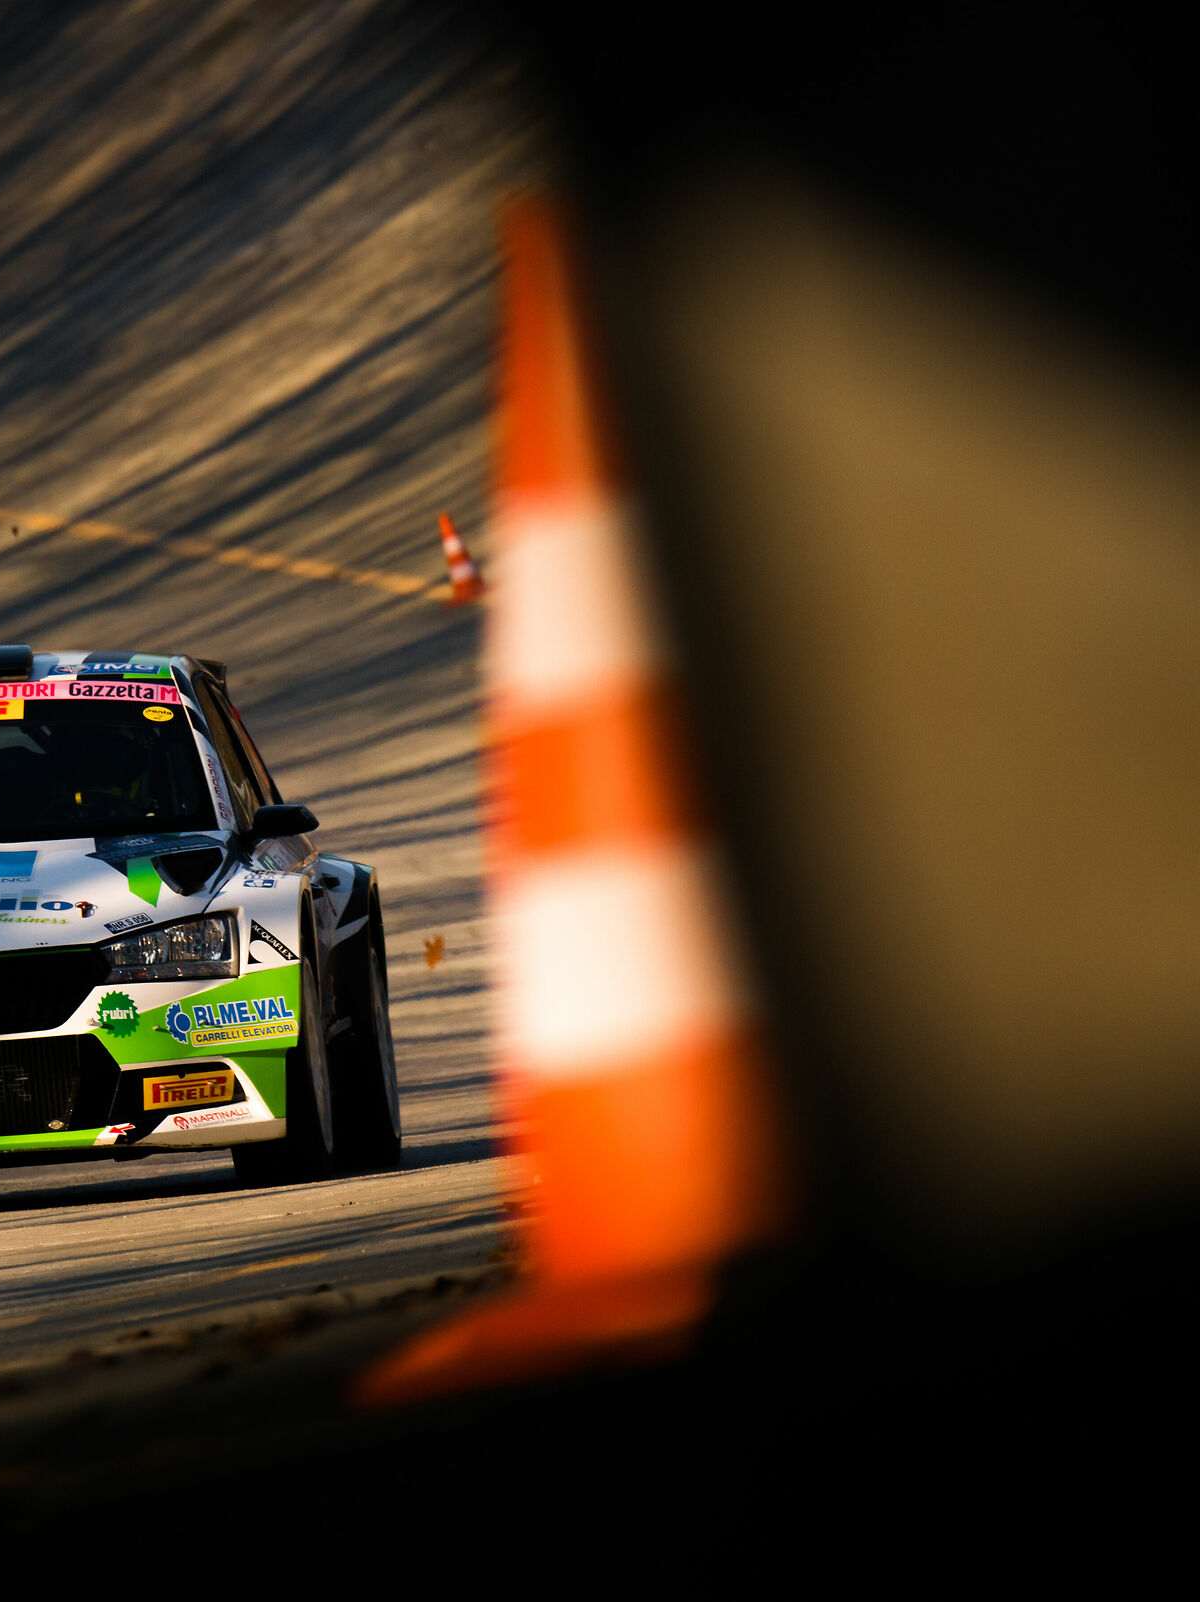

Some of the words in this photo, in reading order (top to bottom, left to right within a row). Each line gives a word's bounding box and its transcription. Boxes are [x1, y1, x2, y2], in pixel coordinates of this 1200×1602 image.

[69, 683, 154, 699] Gazzetta
[160, 687, 182, 701] M
[251, 924, 294, 960] ACQUAFLEX
[193, 996, 293, 1027] RI.ME.VAL
[196, 1030, 240, 1044] CARRELLI
[242, 1024, 294, 1039] ELEVATORI
[152, 1076, 228, 1104] PIRELLI
